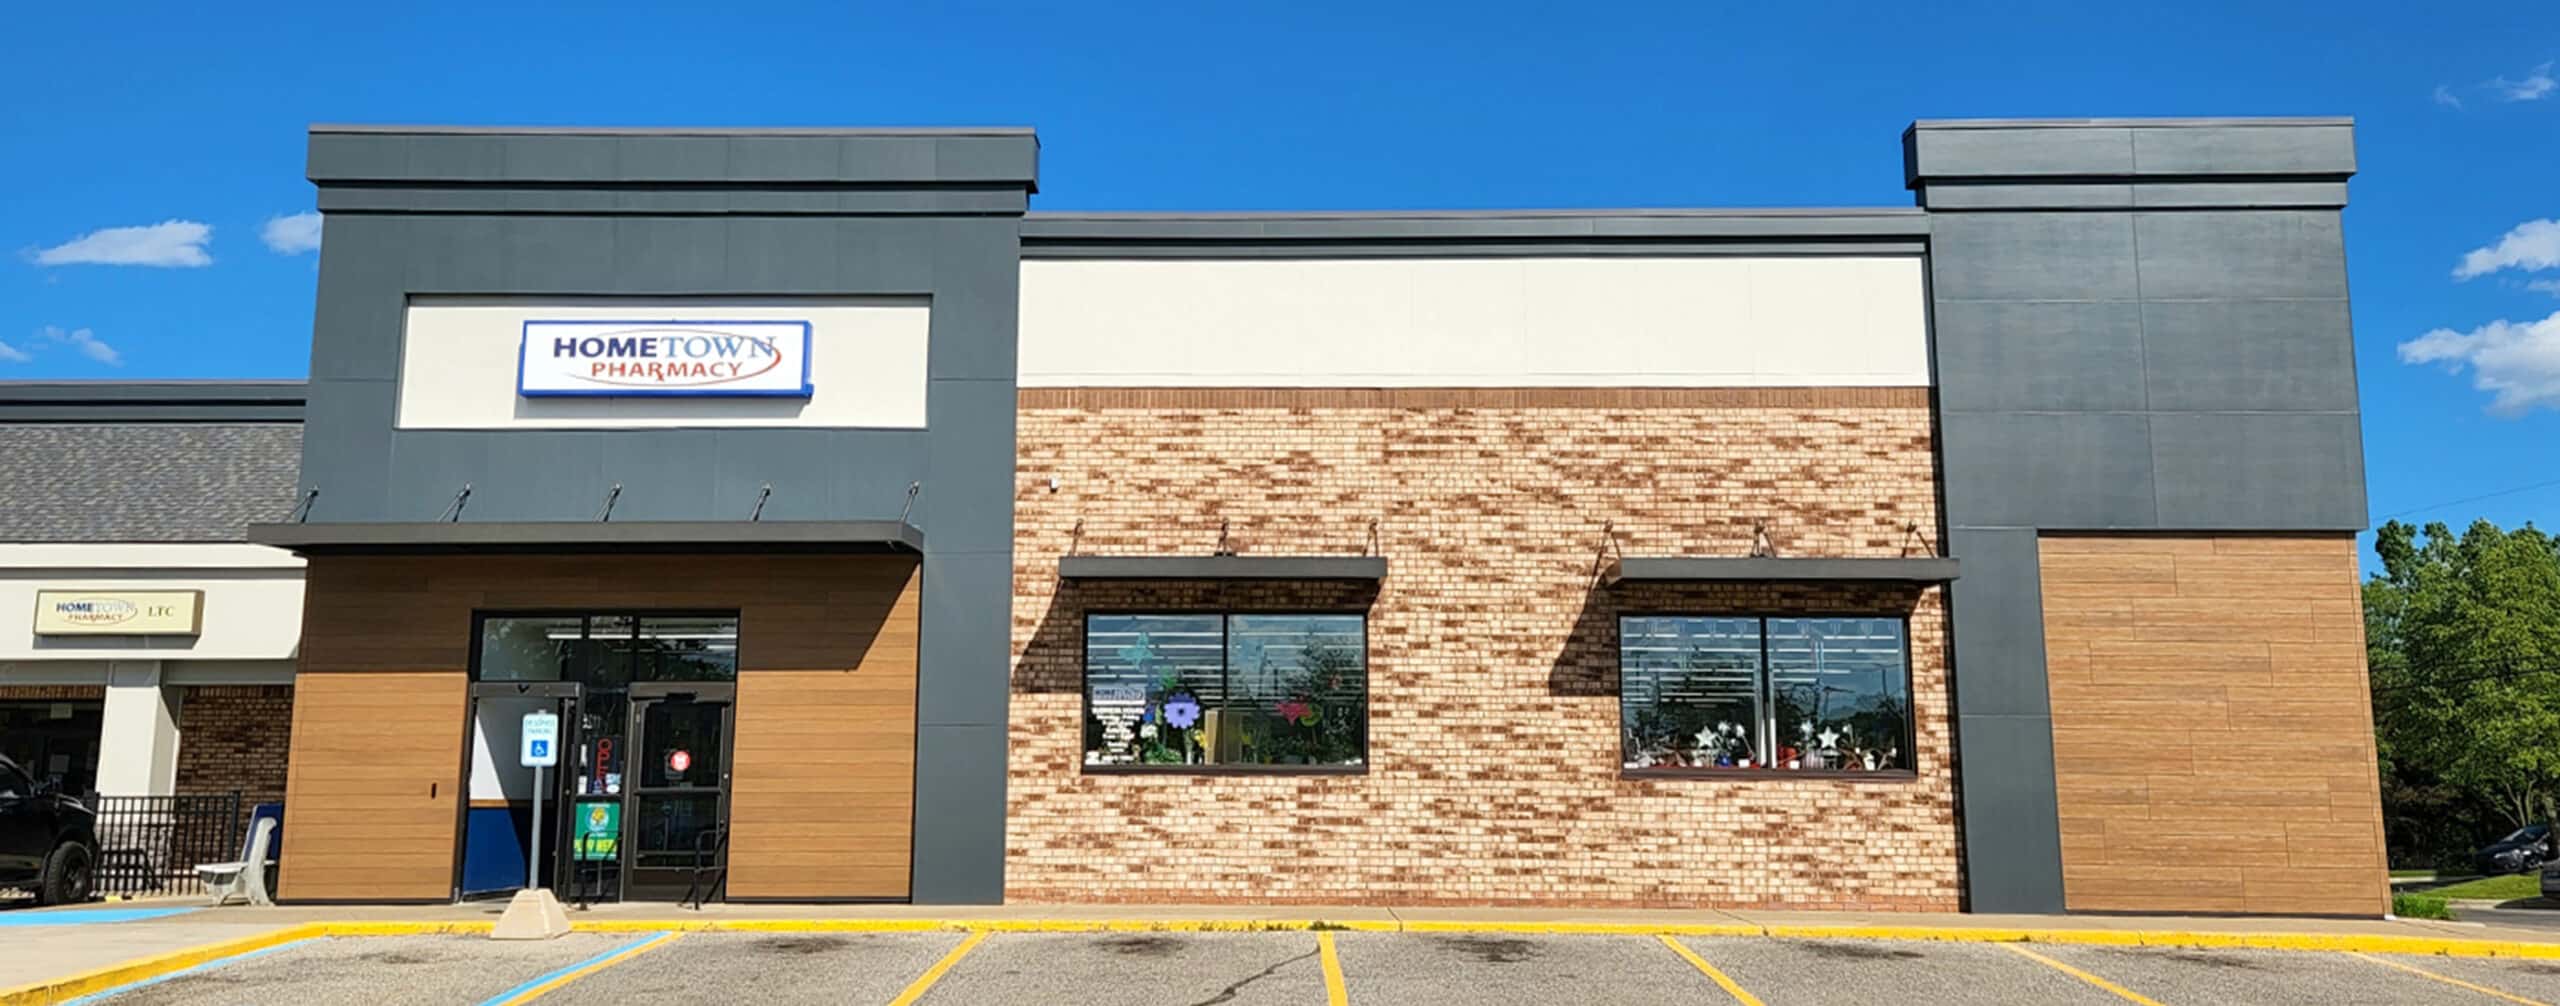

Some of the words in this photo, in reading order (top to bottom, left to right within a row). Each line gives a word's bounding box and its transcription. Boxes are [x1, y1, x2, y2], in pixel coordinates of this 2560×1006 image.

[553, 336, 777, 358] HOMETOWN
[591, 361, 744, 382] PHARMACY
[147, 605, 175, 617] LTC
